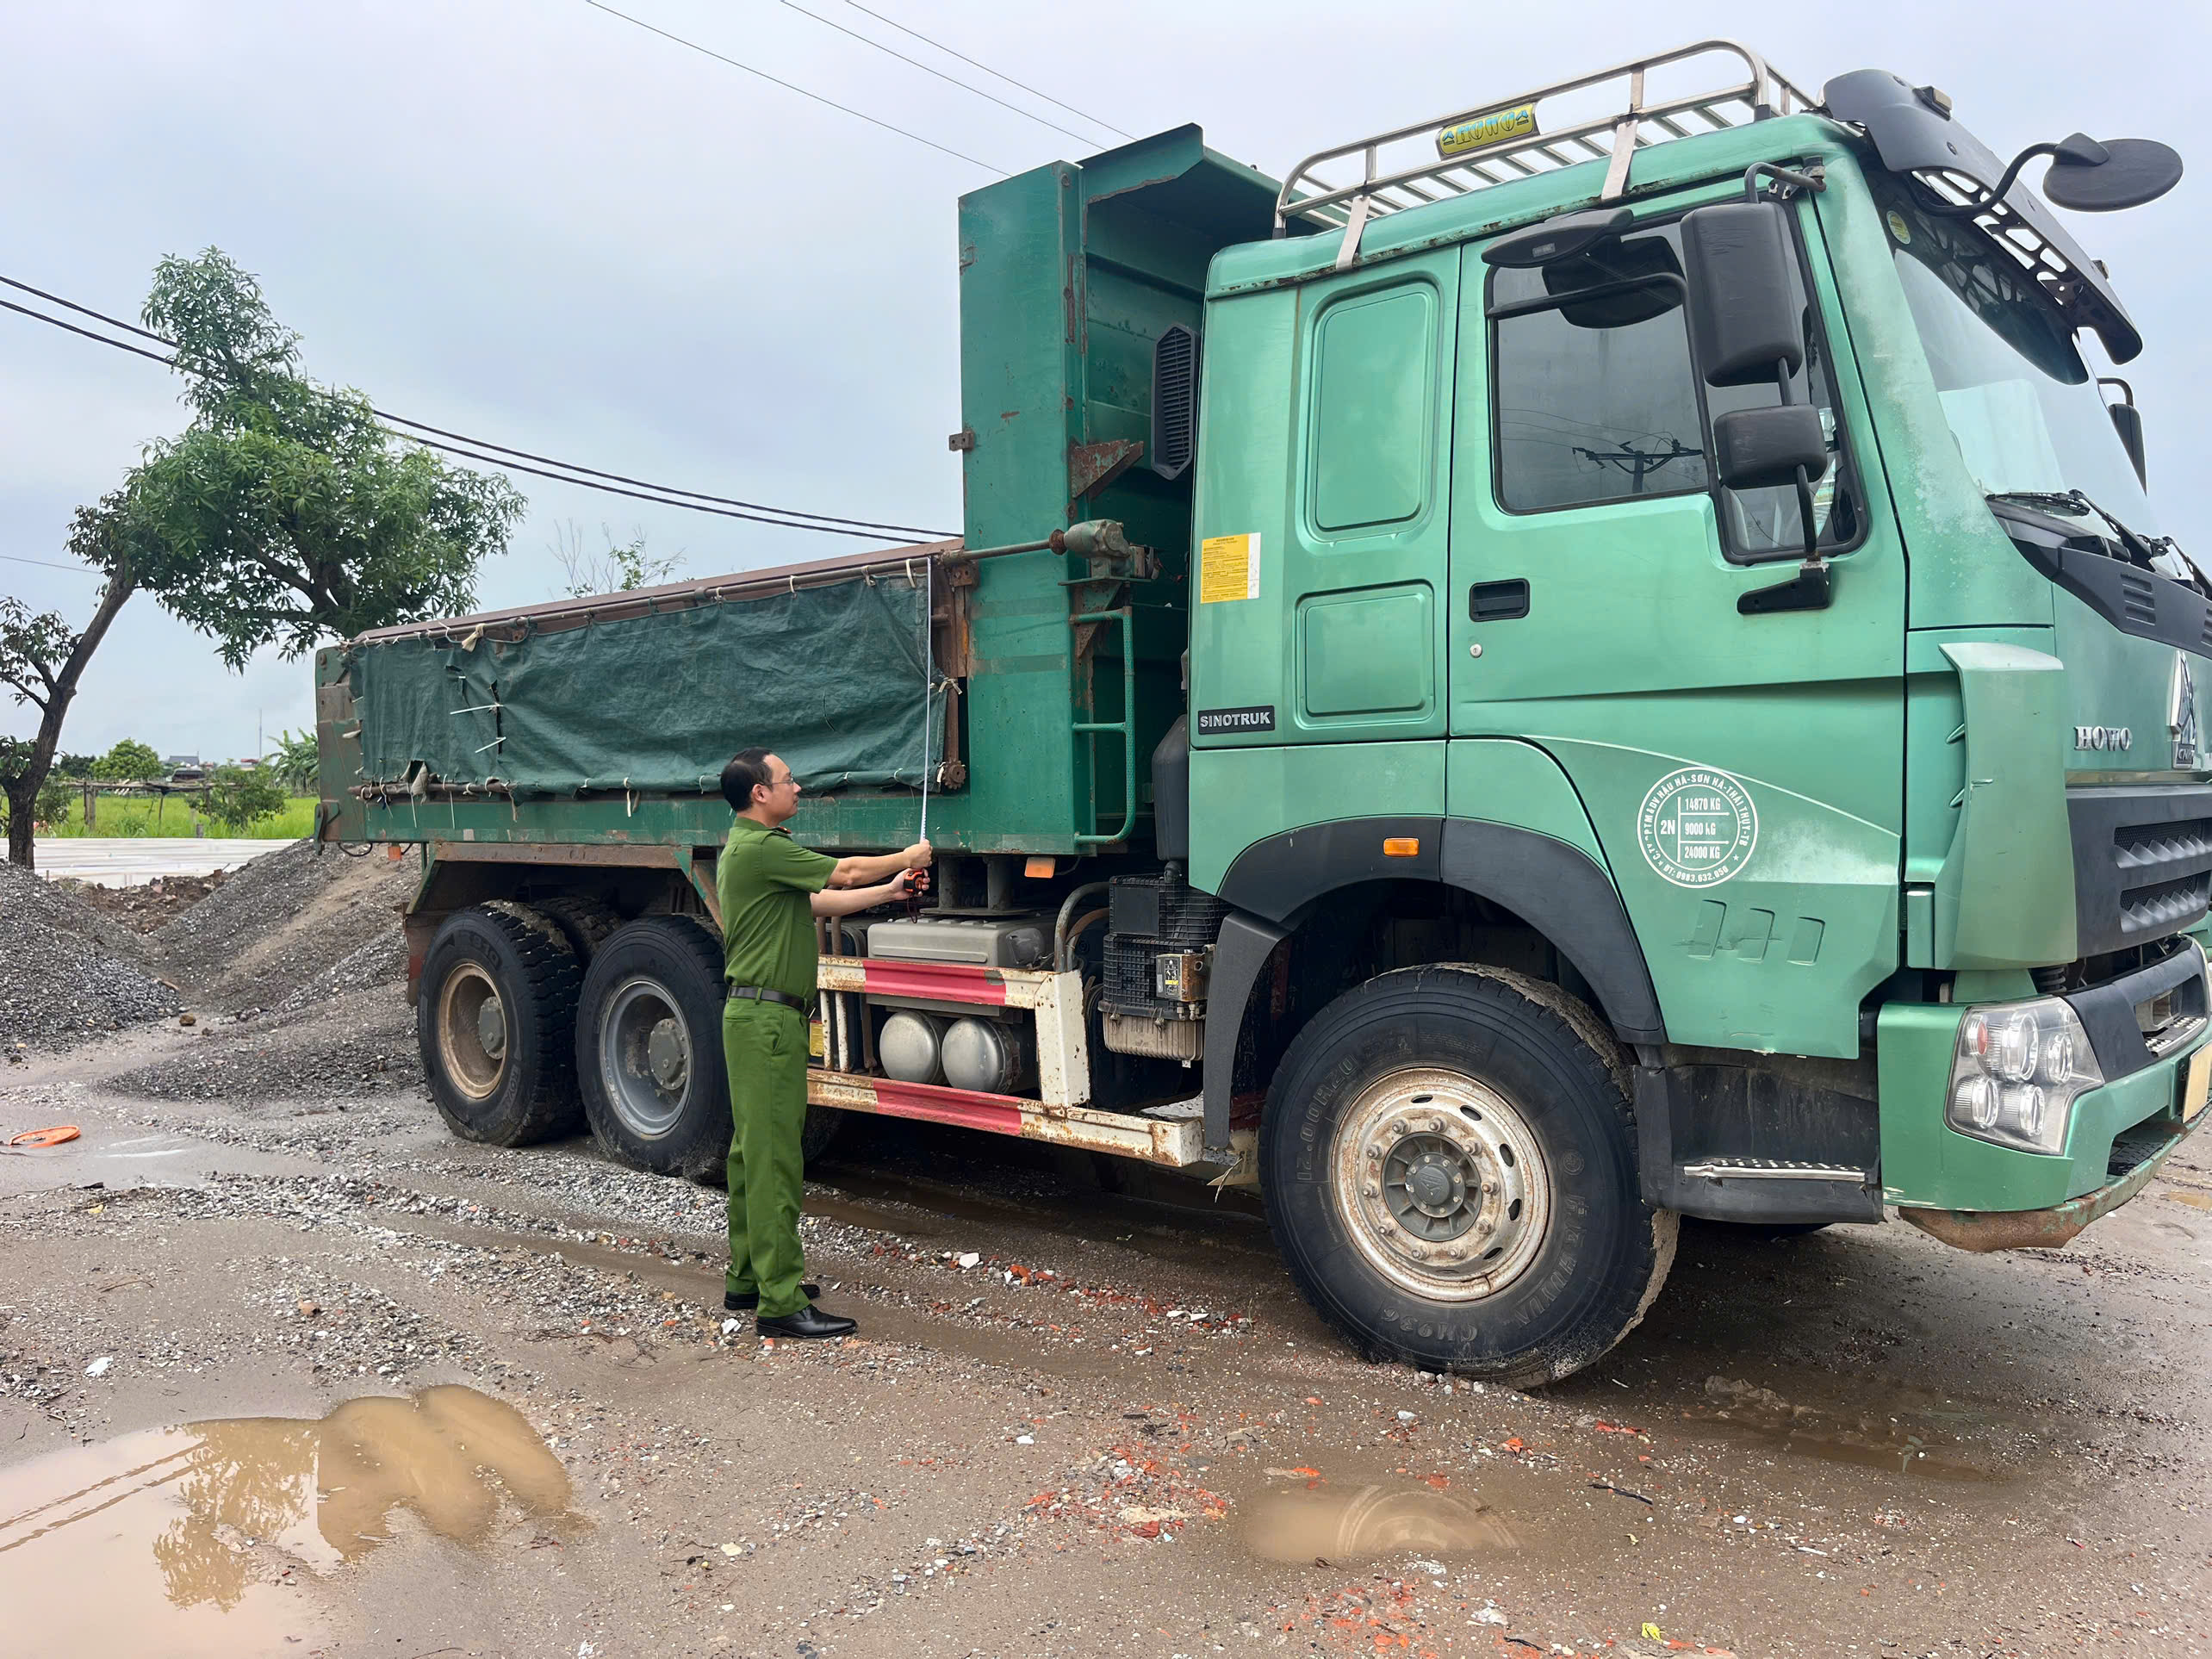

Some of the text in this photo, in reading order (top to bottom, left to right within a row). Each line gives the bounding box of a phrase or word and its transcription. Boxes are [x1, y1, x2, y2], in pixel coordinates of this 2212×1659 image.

[1200, 711, 1271, 728] SINOTRUK
[2073, 725, 2132, 751] HOWO
[1685, 798, 1721, 811] 14870 KG
[1660, 819, 1675, 835] 2N
[1685, 822, 1704, 836] 9000
[1684, 845, 1721, 860] 24000 KG
[1296, 1053, 1359, 1180] 12.00R20
